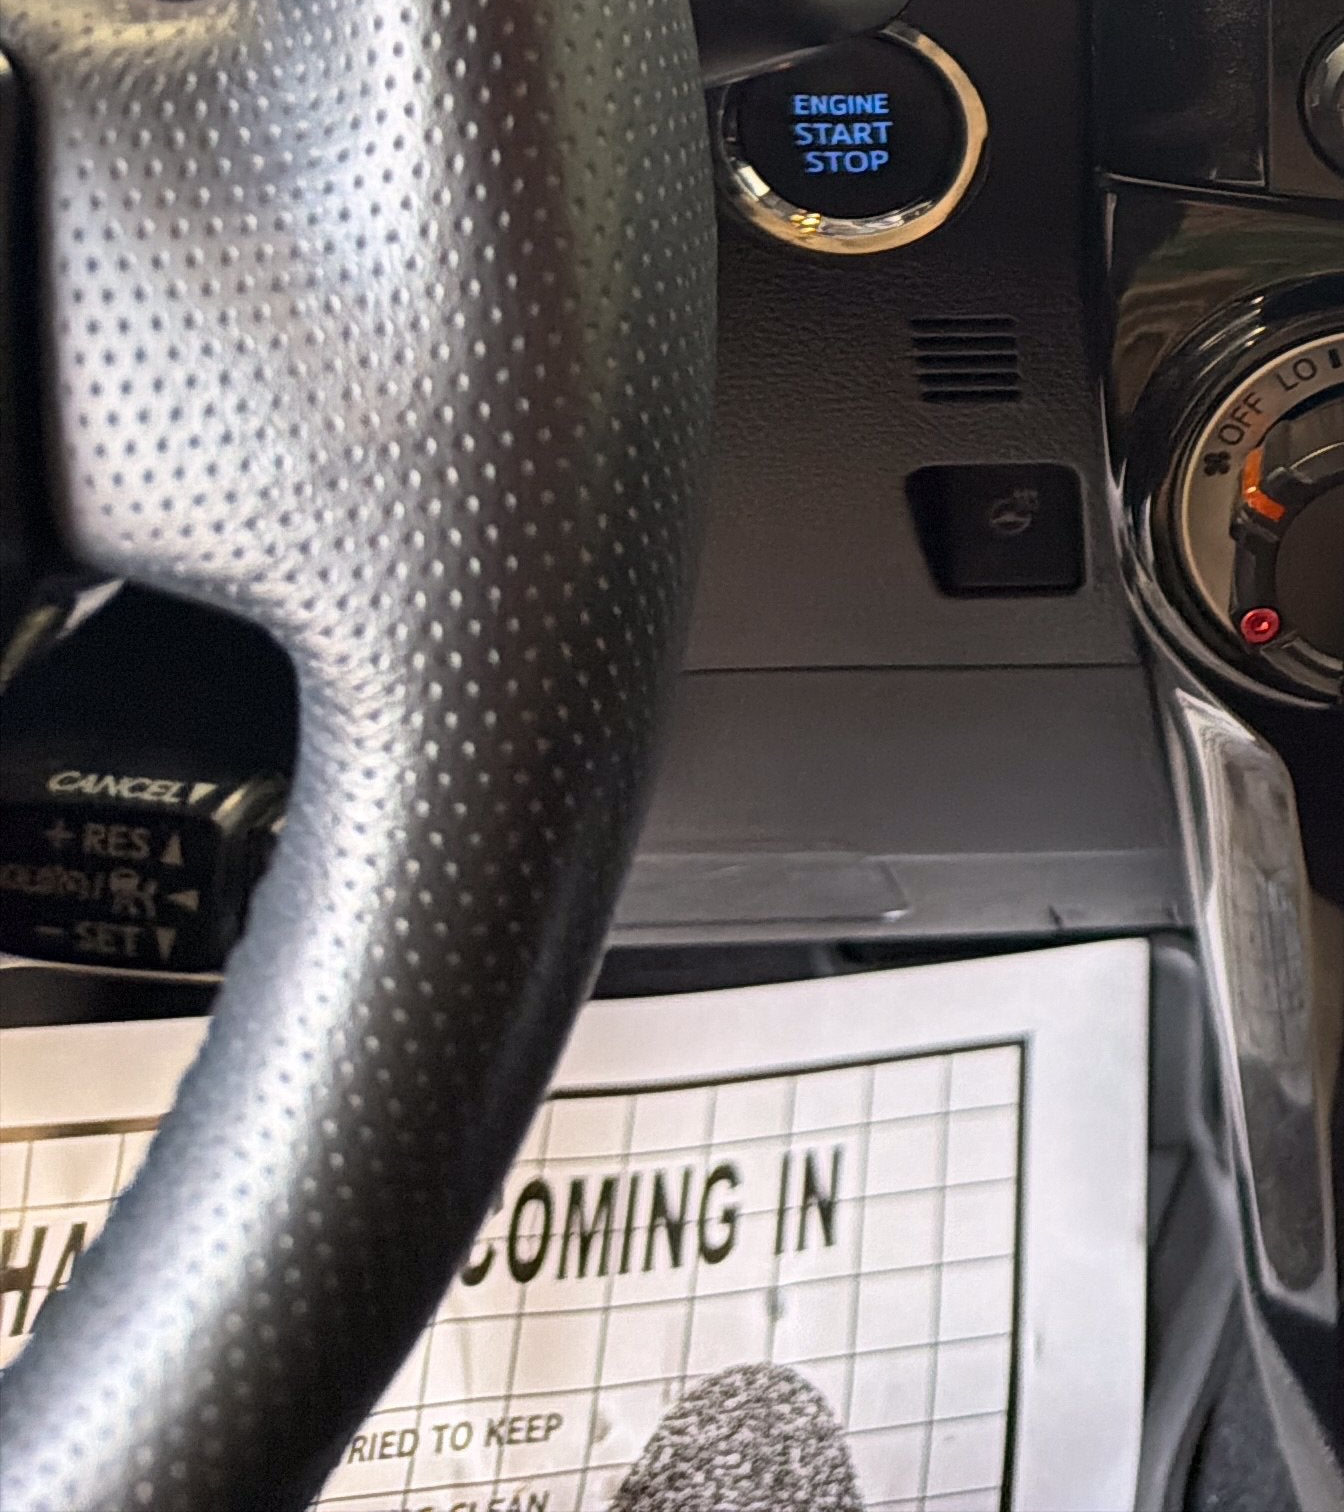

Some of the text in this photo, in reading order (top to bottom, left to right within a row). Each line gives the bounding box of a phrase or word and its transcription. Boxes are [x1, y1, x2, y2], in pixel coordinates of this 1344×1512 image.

[793, 93, 889, 115] ENGINE
[794, 122, 893, 145] START
[805, 151, 889, 173] STOP
[1276, 358, 1317, 391] LO
[1218, 392, 1263, 446] OFF
[46, 770, 184, 803] CANCEL
[775, 1142, 844, 1256] IN
[347, 1412, 563, 1464] RIED TO KEEP
